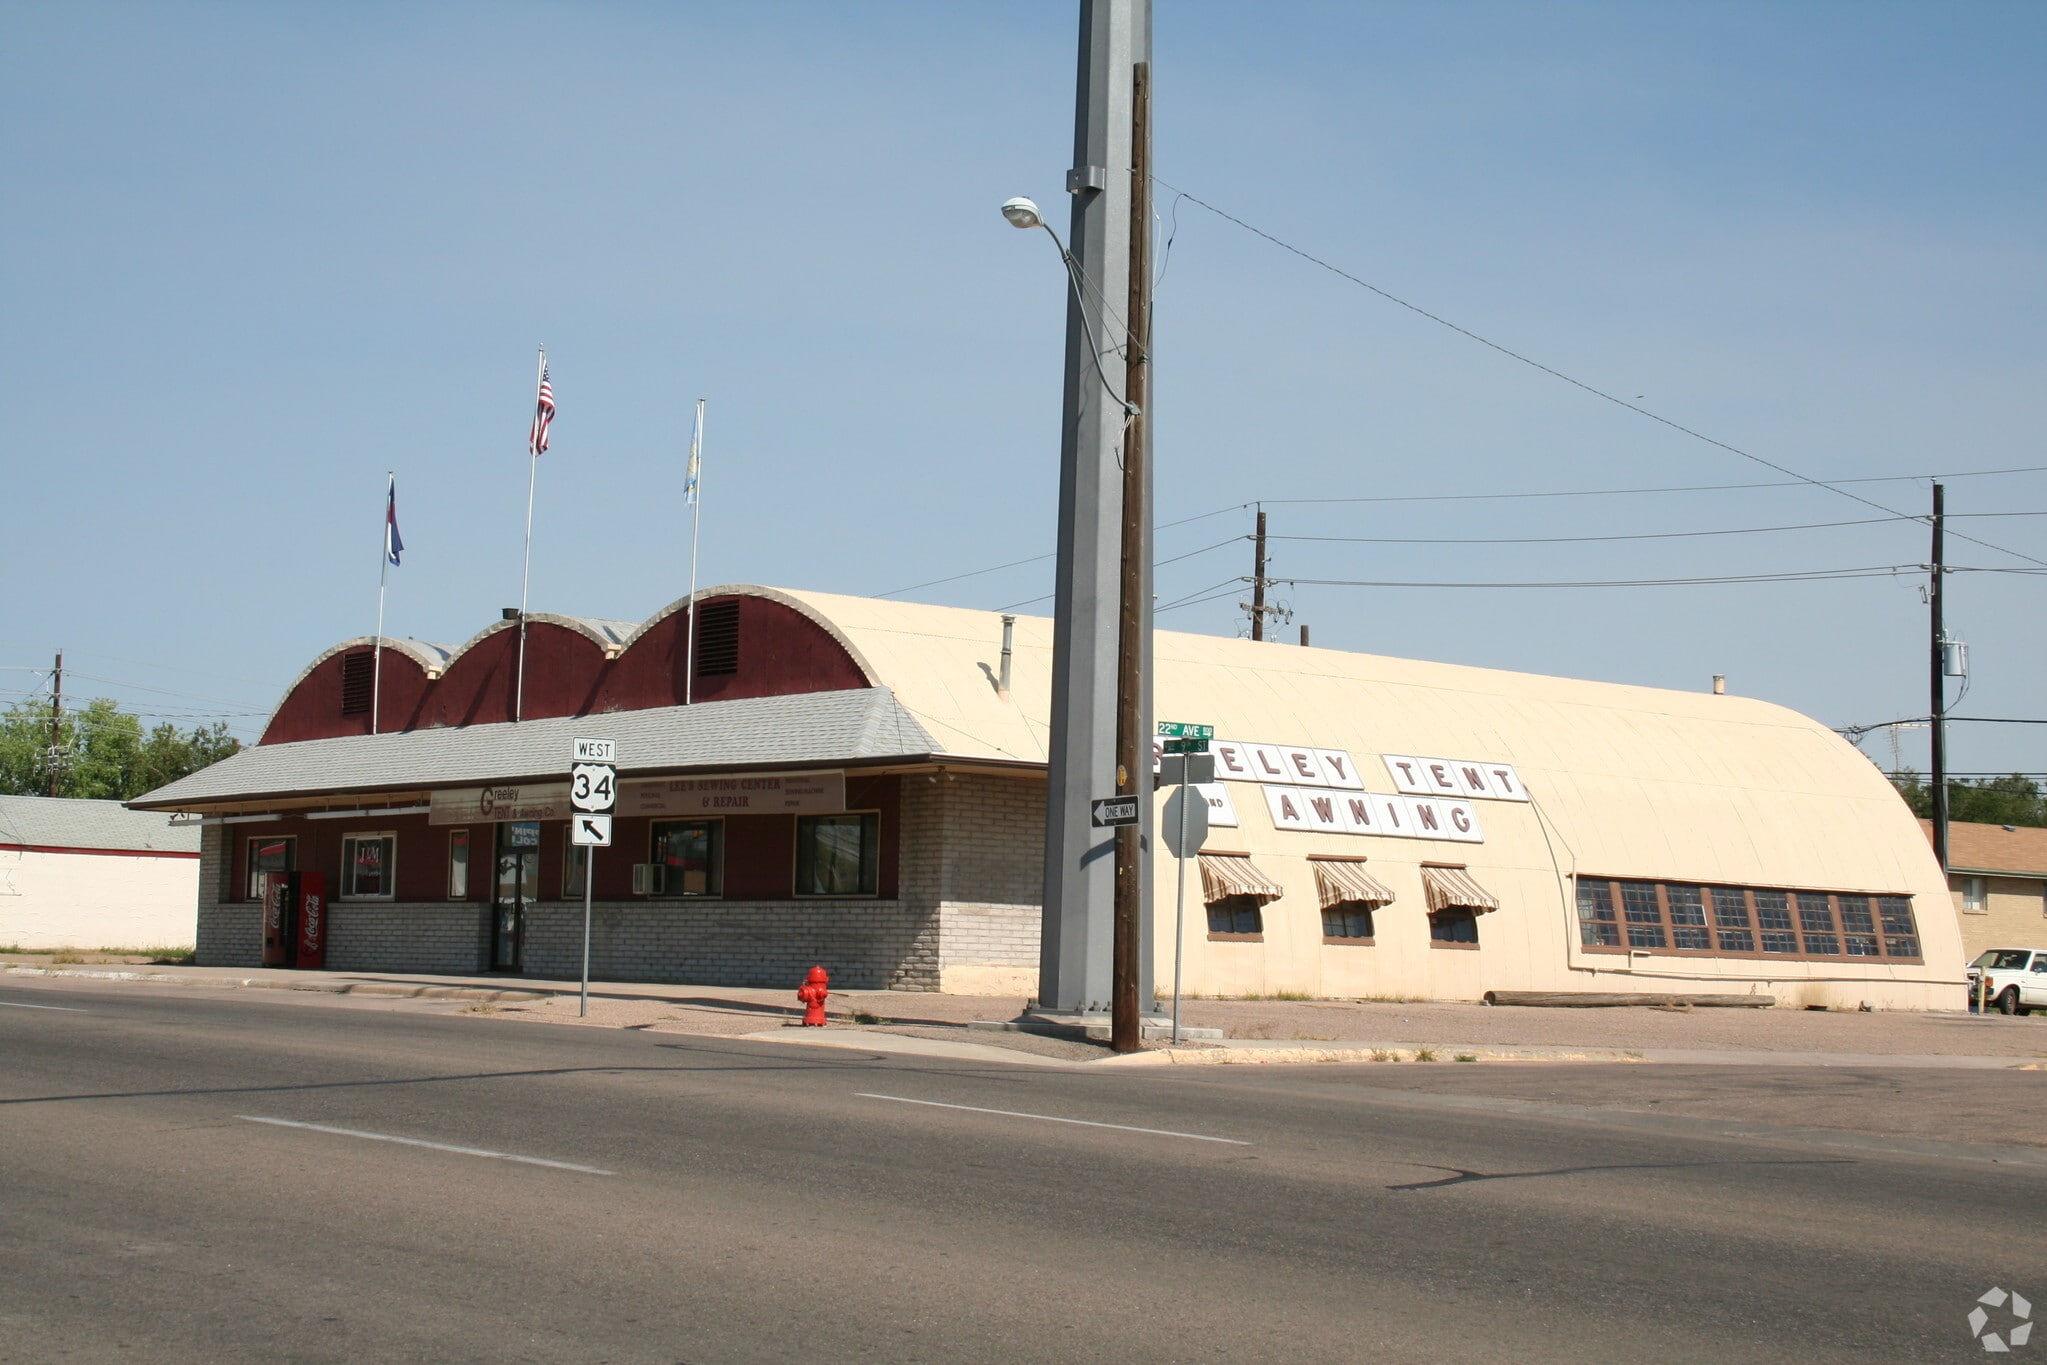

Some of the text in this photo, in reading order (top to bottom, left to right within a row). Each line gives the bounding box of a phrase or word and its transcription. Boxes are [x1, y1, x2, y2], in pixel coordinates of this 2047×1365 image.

[1182, 725, 1200, 737] AVE
[579, 742, 611, 757] WEST
[1197, 740, 1207, 752] ST
[697, 778, 737, 791] SEWING
[741, 777, 781, 790] CENTER
[1396, 761, 1512, 793] TENT
[574, 773, 612, 801] 34
[480, 786, 520, 816] Greeley
[713, 796, 749, 807] REPAIR
[494, 806, 511, 819] TENT
[520, 808, 543, 820] Awning
[1105, 804, 1134, 818] ONE WAY
[1281, 793, 1471, 833] AWNING
